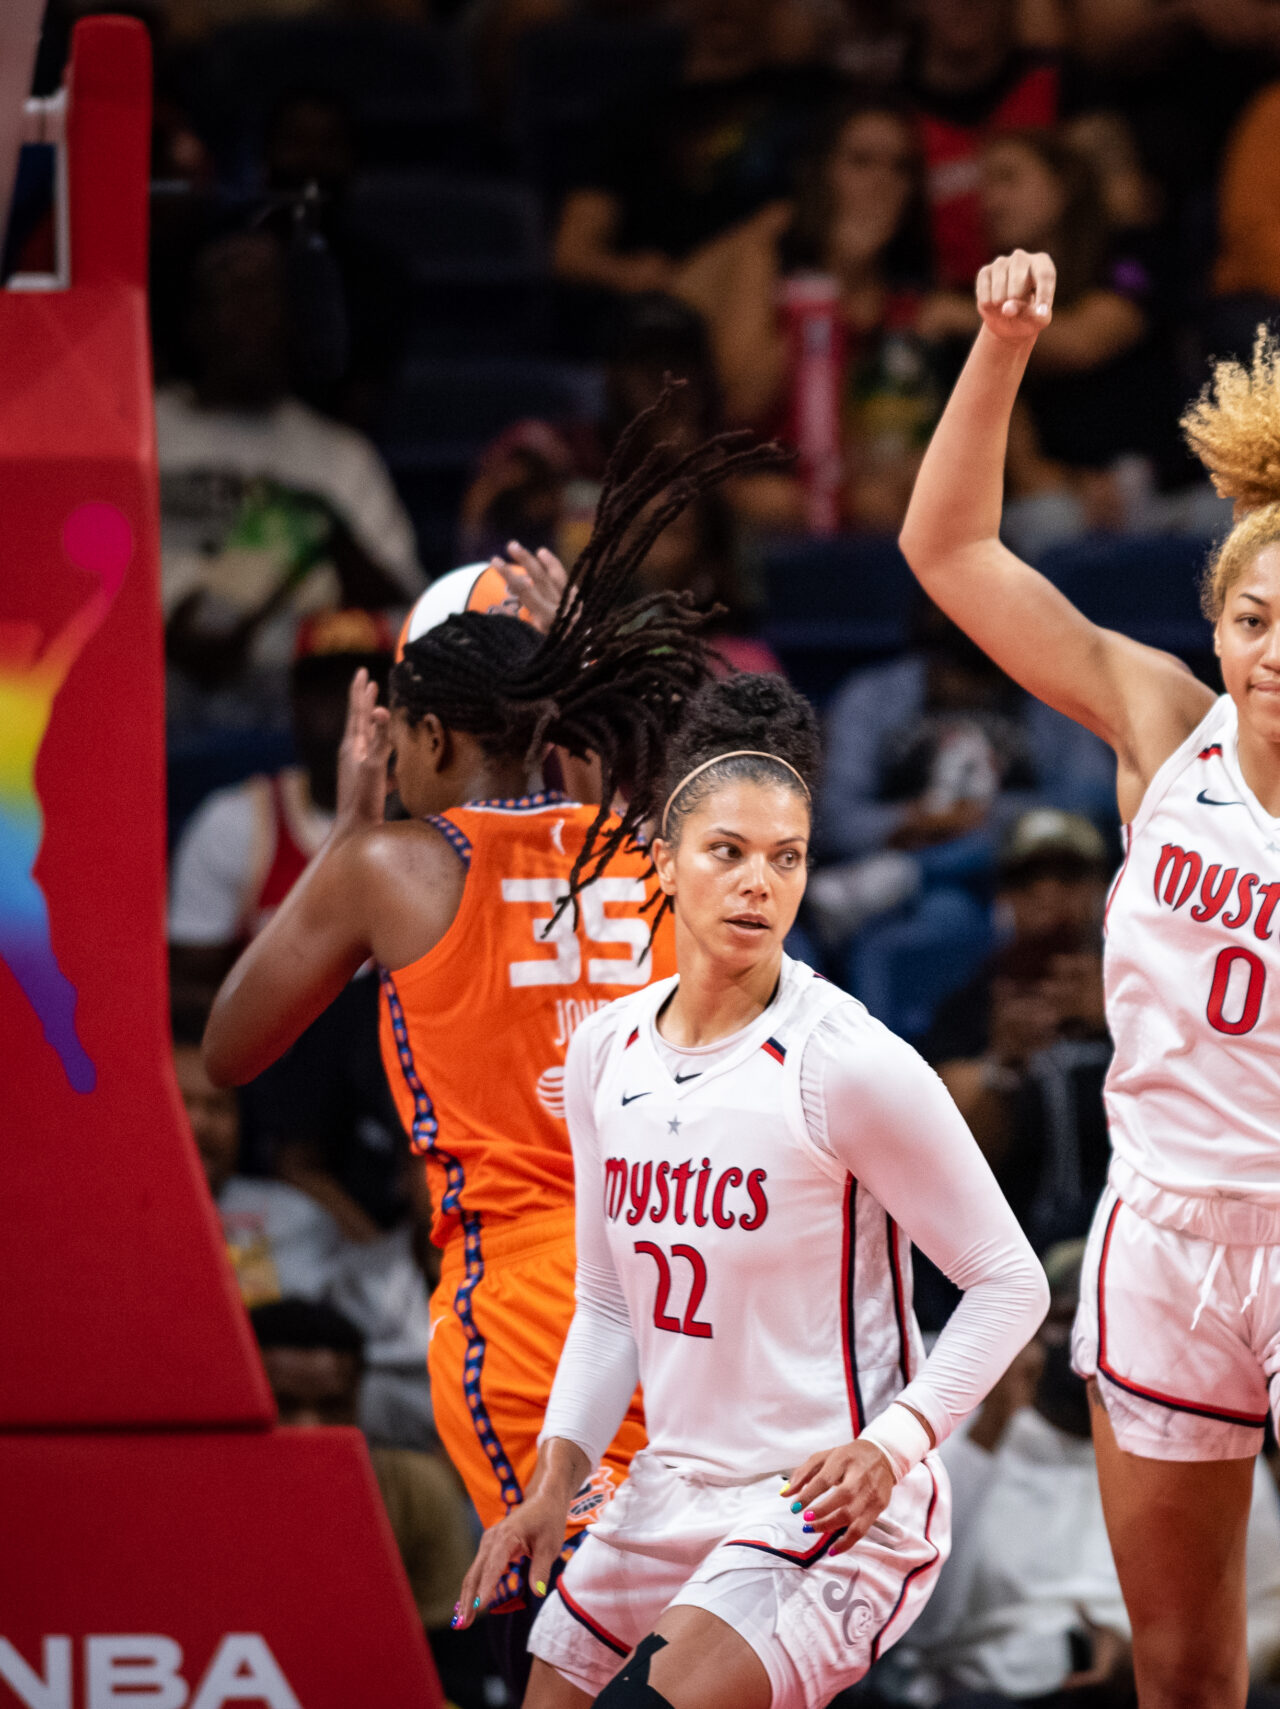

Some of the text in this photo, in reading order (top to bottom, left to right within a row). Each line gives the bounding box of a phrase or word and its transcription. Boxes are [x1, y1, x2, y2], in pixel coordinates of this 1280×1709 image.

[502, 877, 653, 988] 35
[1207, 946, 1266, 1035] 0
[634, 1241, 713, 1339] 22
